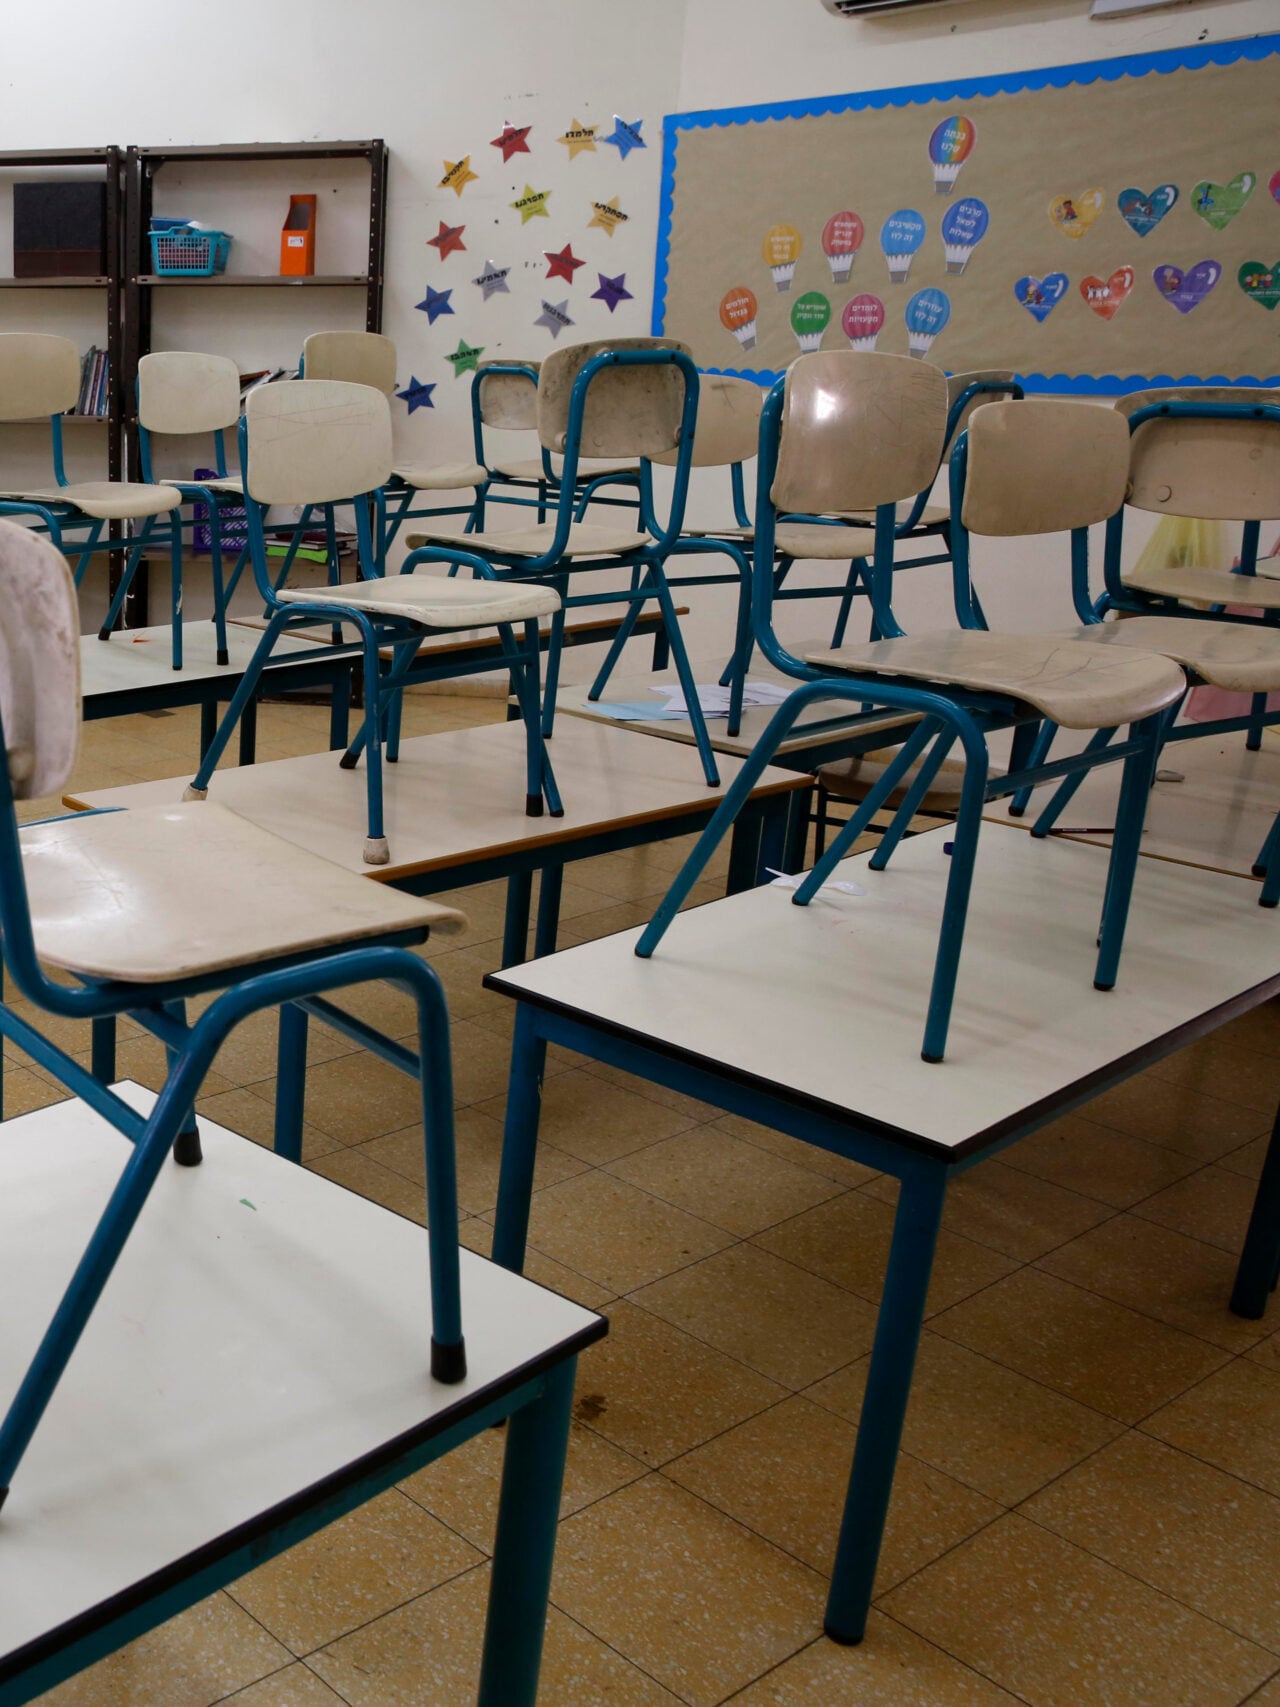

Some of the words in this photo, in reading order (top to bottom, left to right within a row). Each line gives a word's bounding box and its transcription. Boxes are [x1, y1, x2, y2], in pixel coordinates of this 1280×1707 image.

[565, 128, 594, 138] תלמדו
[940, 142, 961, 153] שלנו
[515, 192, 544, 208] תפרגנו
[594, 202, 628, 221] תסתקרנו
[476, 269, 508, 285] תאמינו
[852, 304, 878, 312] לומדים
